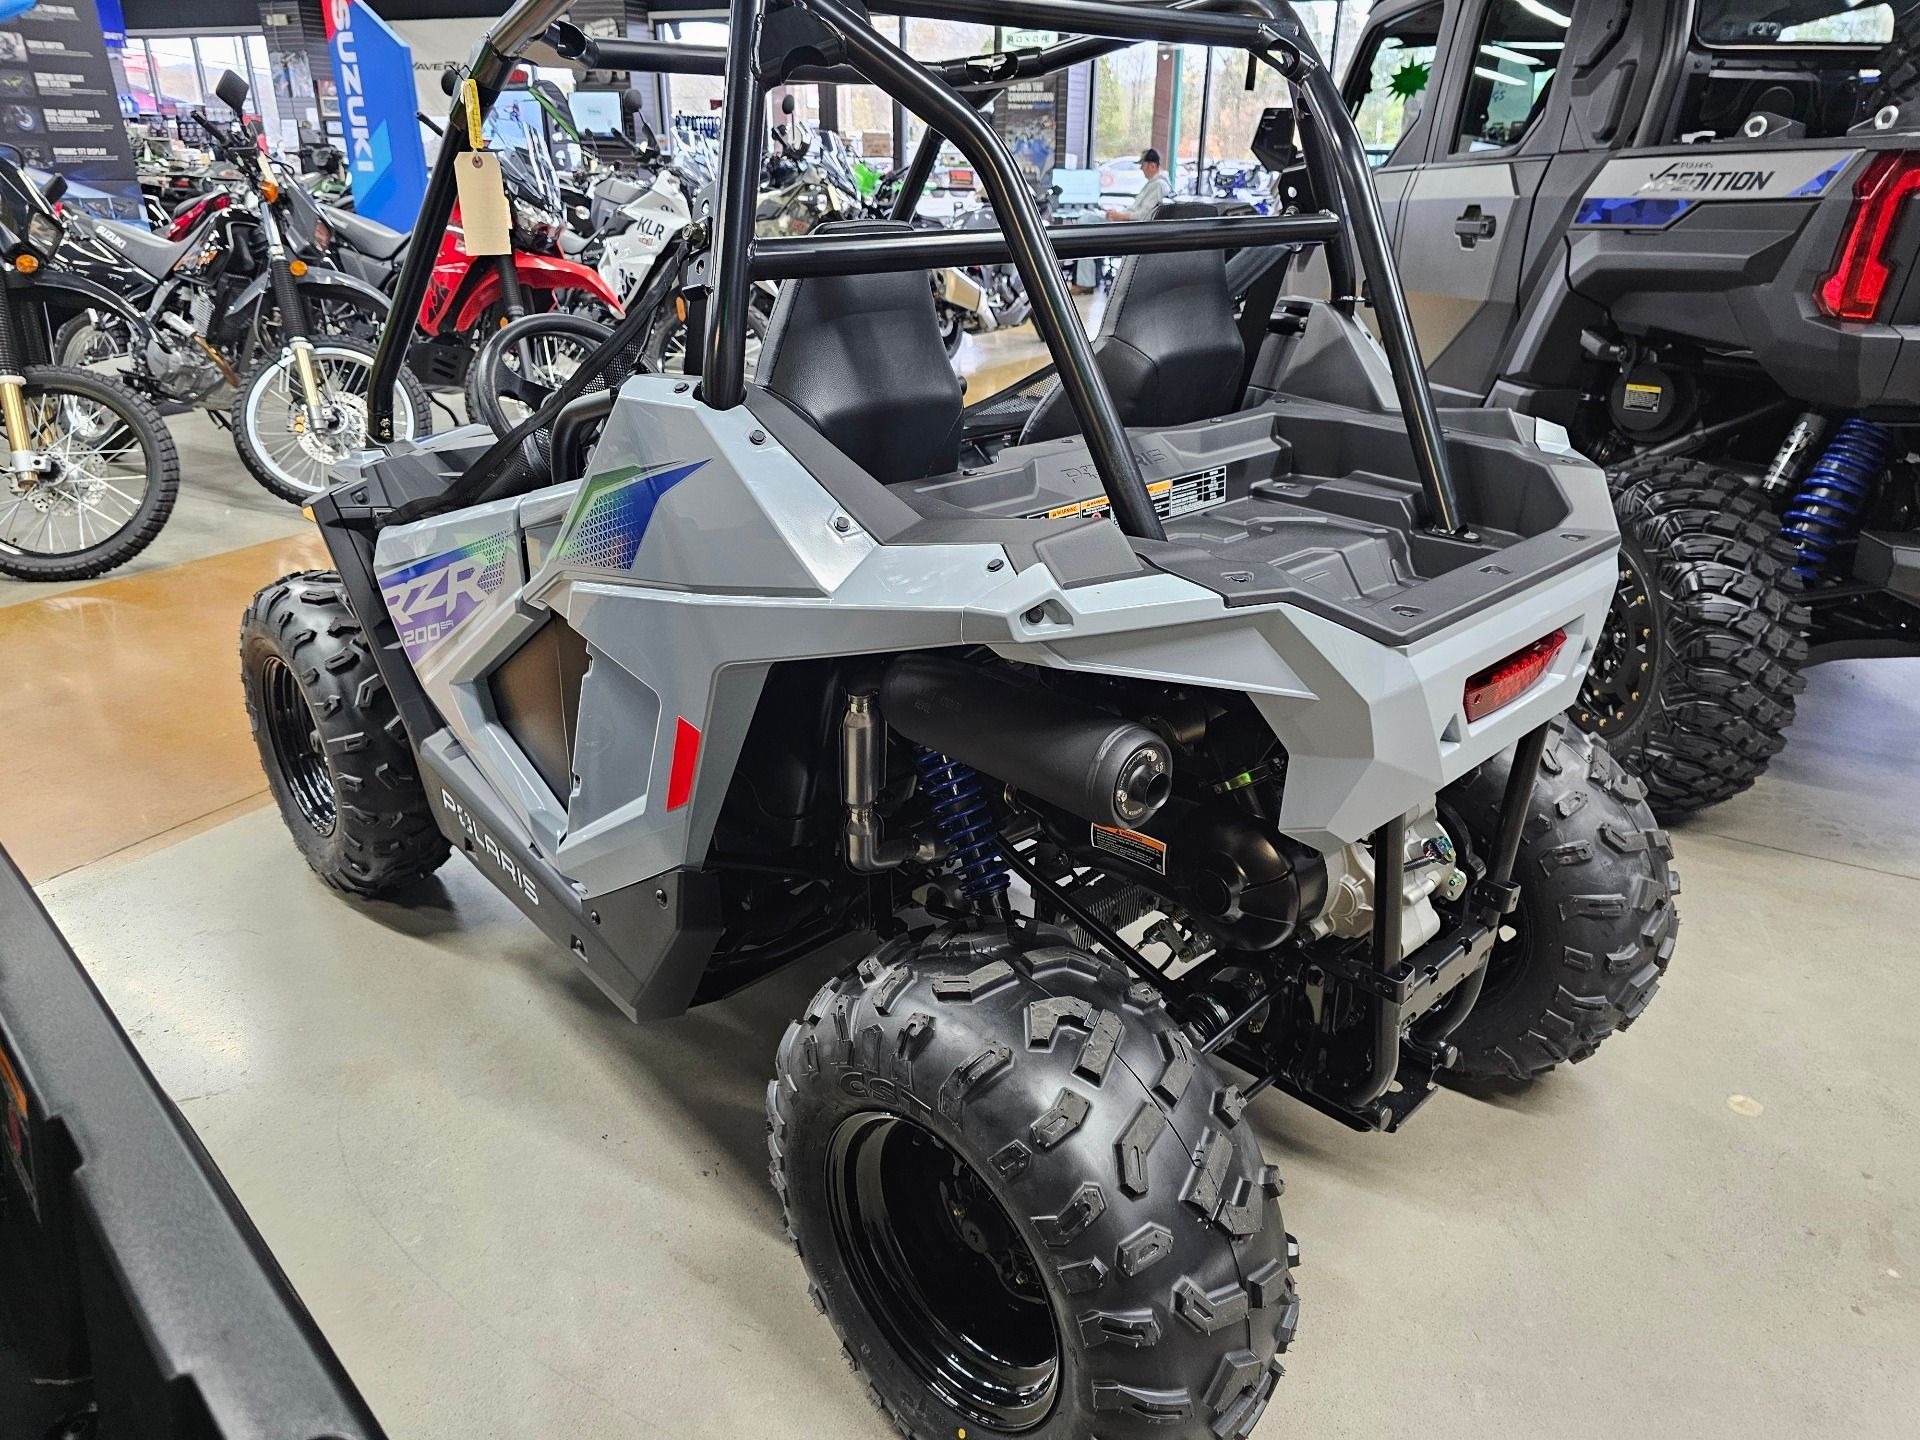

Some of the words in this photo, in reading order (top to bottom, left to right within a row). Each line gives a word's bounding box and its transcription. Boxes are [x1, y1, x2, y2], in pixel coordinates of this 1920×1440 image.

[330, 0, 375, 172] SUZUKI
[1634, 162, 1776, 195] XPEDITION
[95, 225, 127, 249] SUZUKI
[635, 216, 665, 240] KLR
[382, 560, 484, 625] RZR
[403, 622, 440, 647] 200
[441, 787, 539, 906] POLARIS
[839, 1071, 932, 1120] CST
